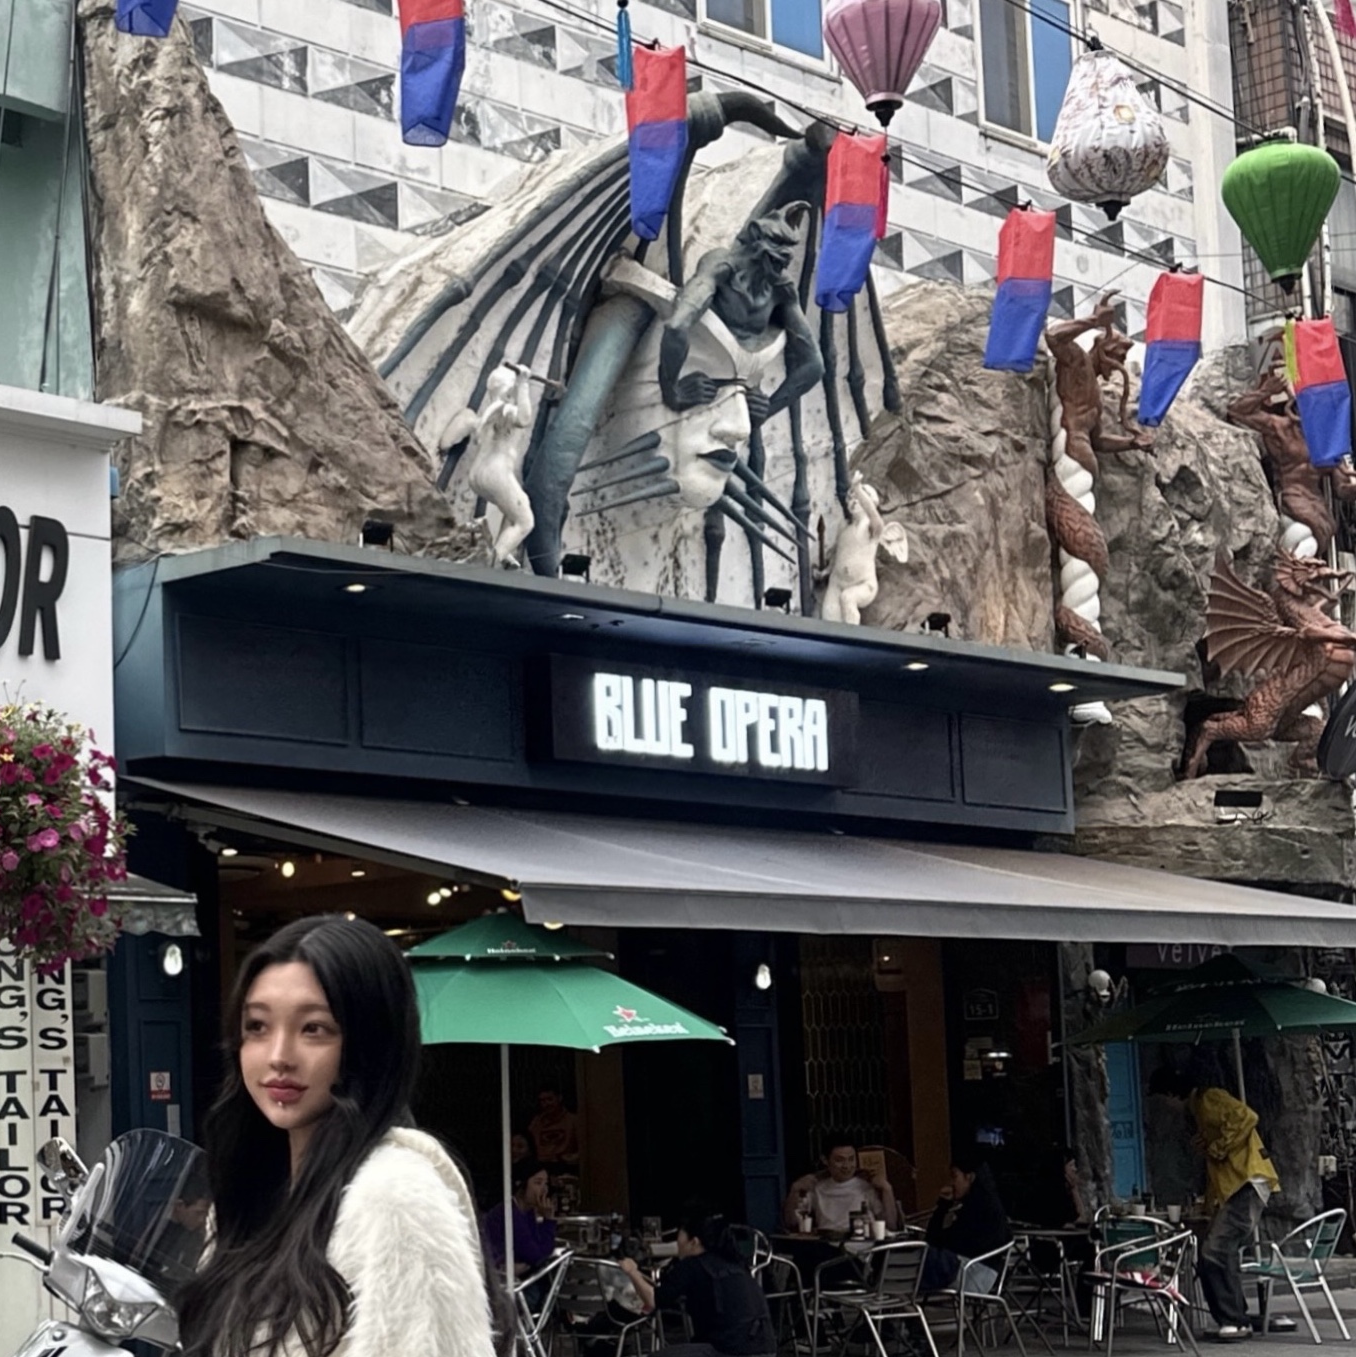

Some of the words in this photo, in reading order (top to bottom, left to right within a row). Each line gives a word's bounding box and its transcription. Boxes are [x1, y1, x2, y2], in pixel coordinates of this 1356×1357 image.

[593, 672, 694, 758] BLUE
[709, 686, 829, 771] OPERA
[38, 1069, 71, 1219] TAIR
